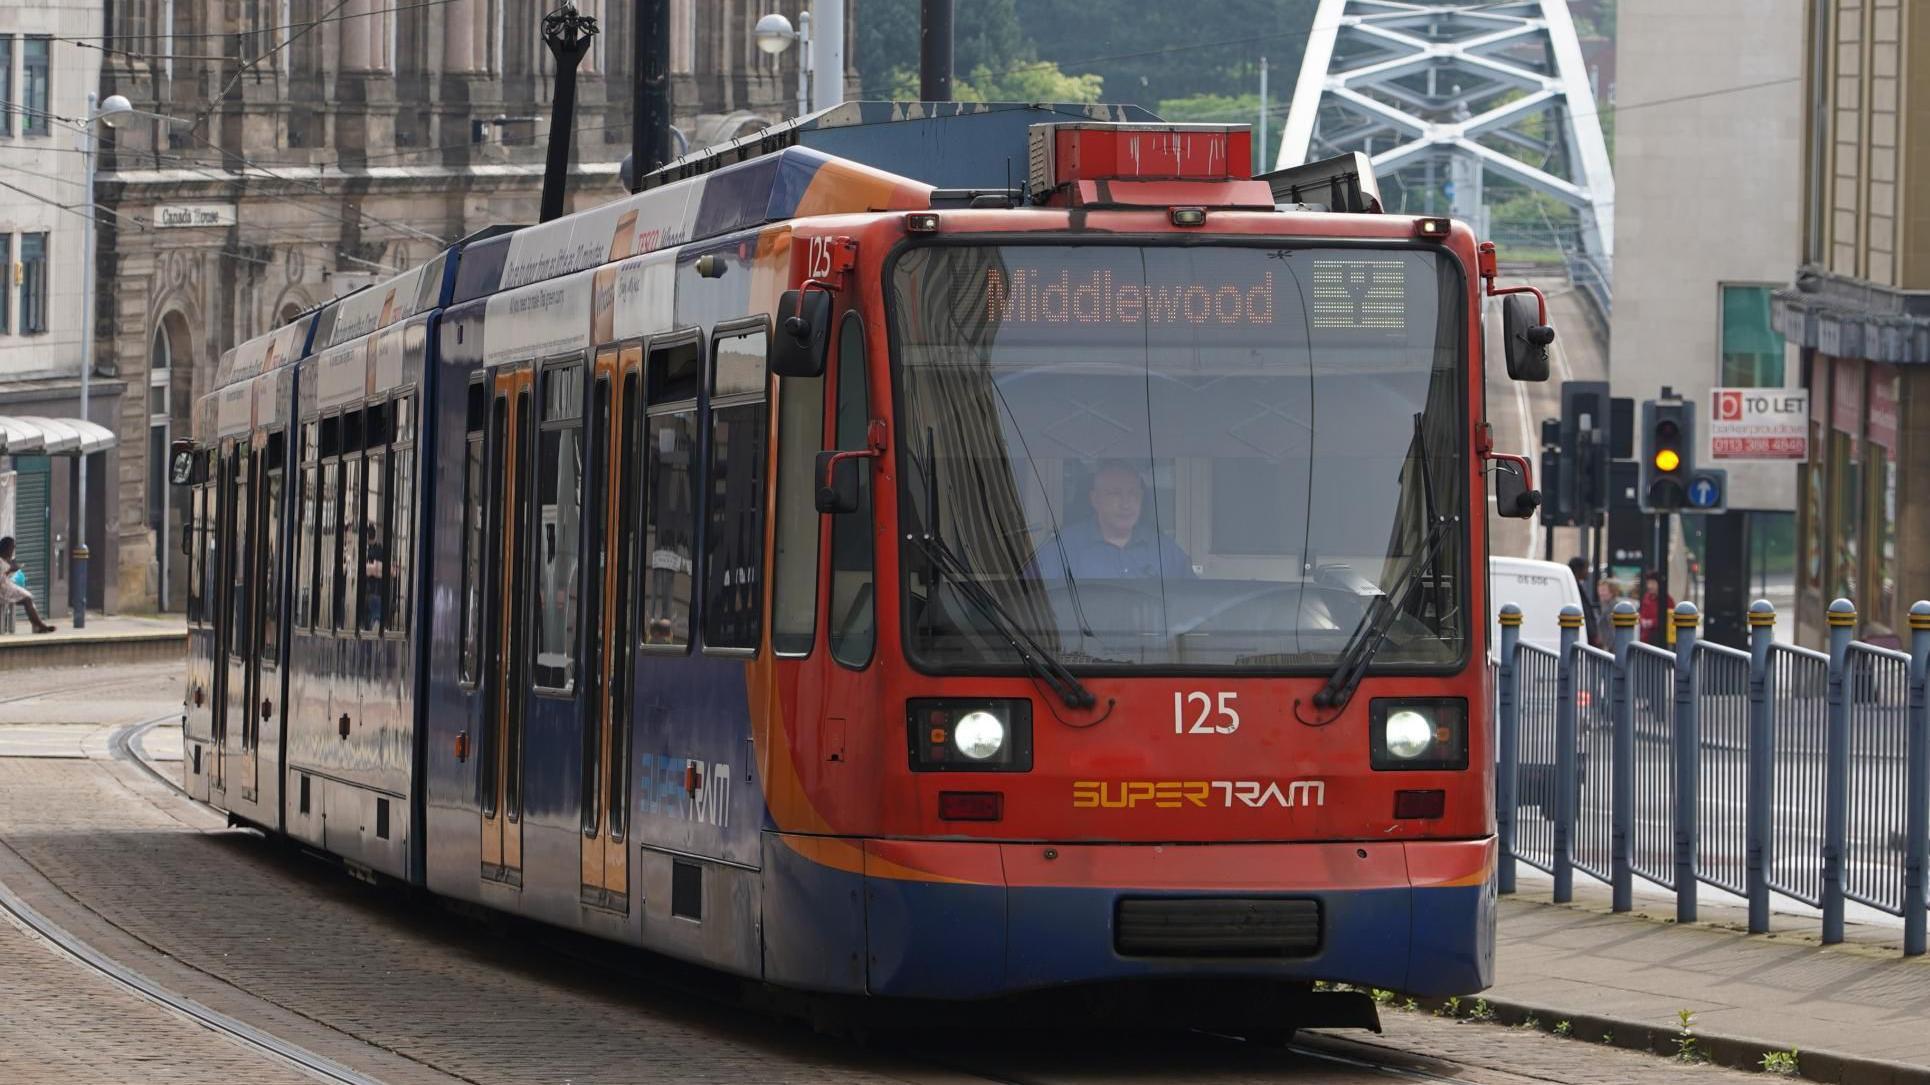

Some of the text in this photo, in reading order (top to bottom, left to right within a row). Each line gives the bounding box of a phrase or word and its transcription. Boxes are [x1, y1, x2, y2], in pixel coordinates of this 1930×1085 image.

[162, 208, 192, 225] Canada
[809, 235, 832, 278] 125
[986, 269, 1273, 323] Middlewood
[1746, 397, 1769, 413] TO
[1774, 397, 1806, 413] LET
[1174, 690, 1240, 734] 125
[1073, 781, 1325, 808] SUPERTRAM
